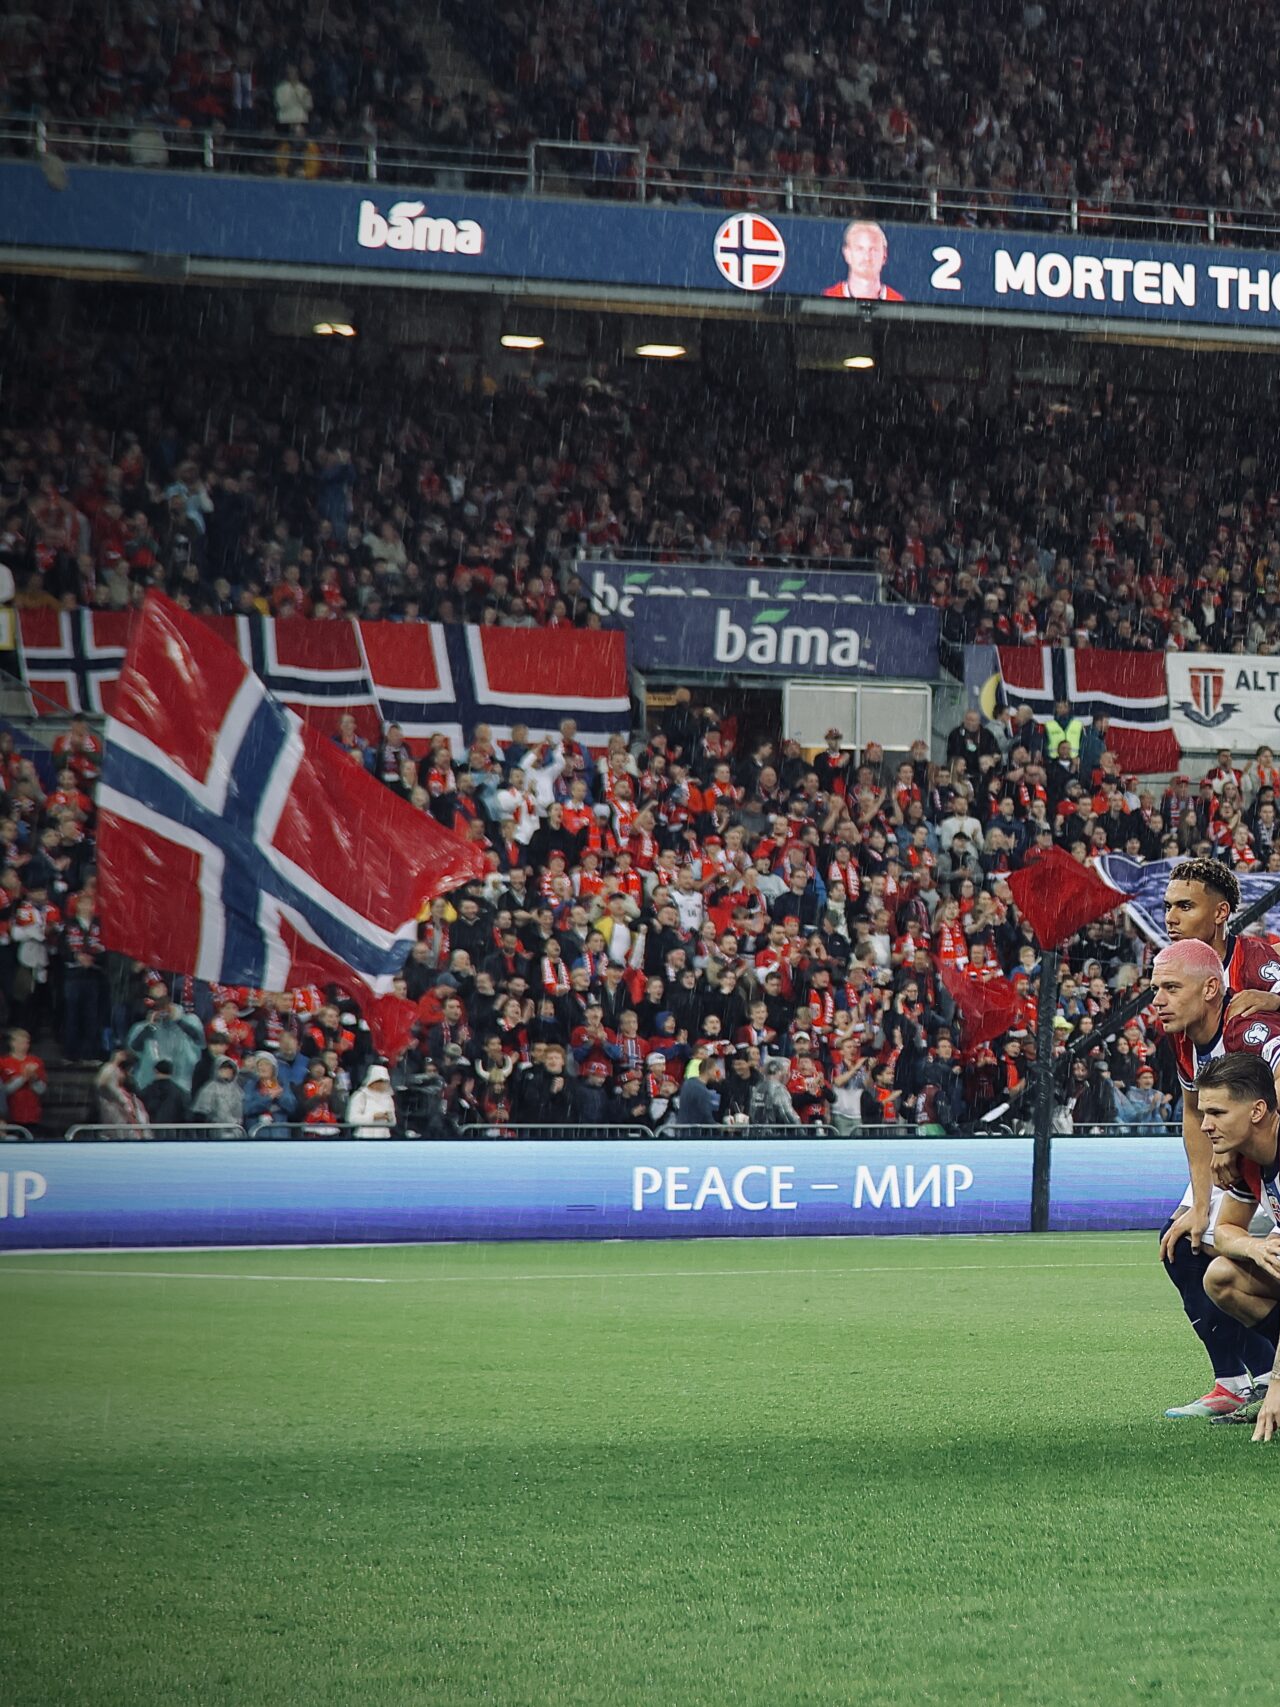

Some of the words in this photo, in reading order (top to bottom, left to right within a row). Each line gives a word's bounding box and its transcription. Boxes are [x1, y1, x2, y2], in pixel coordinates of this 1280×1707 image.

[930, 246, 962, 290] 2
[994, 249, 1196, 307] MORTEN
[1235, 670, 1279, 691] ALT
[632, 1165, 799, 1211] PEACE
[853, 1163, 975, 1208] МИР
